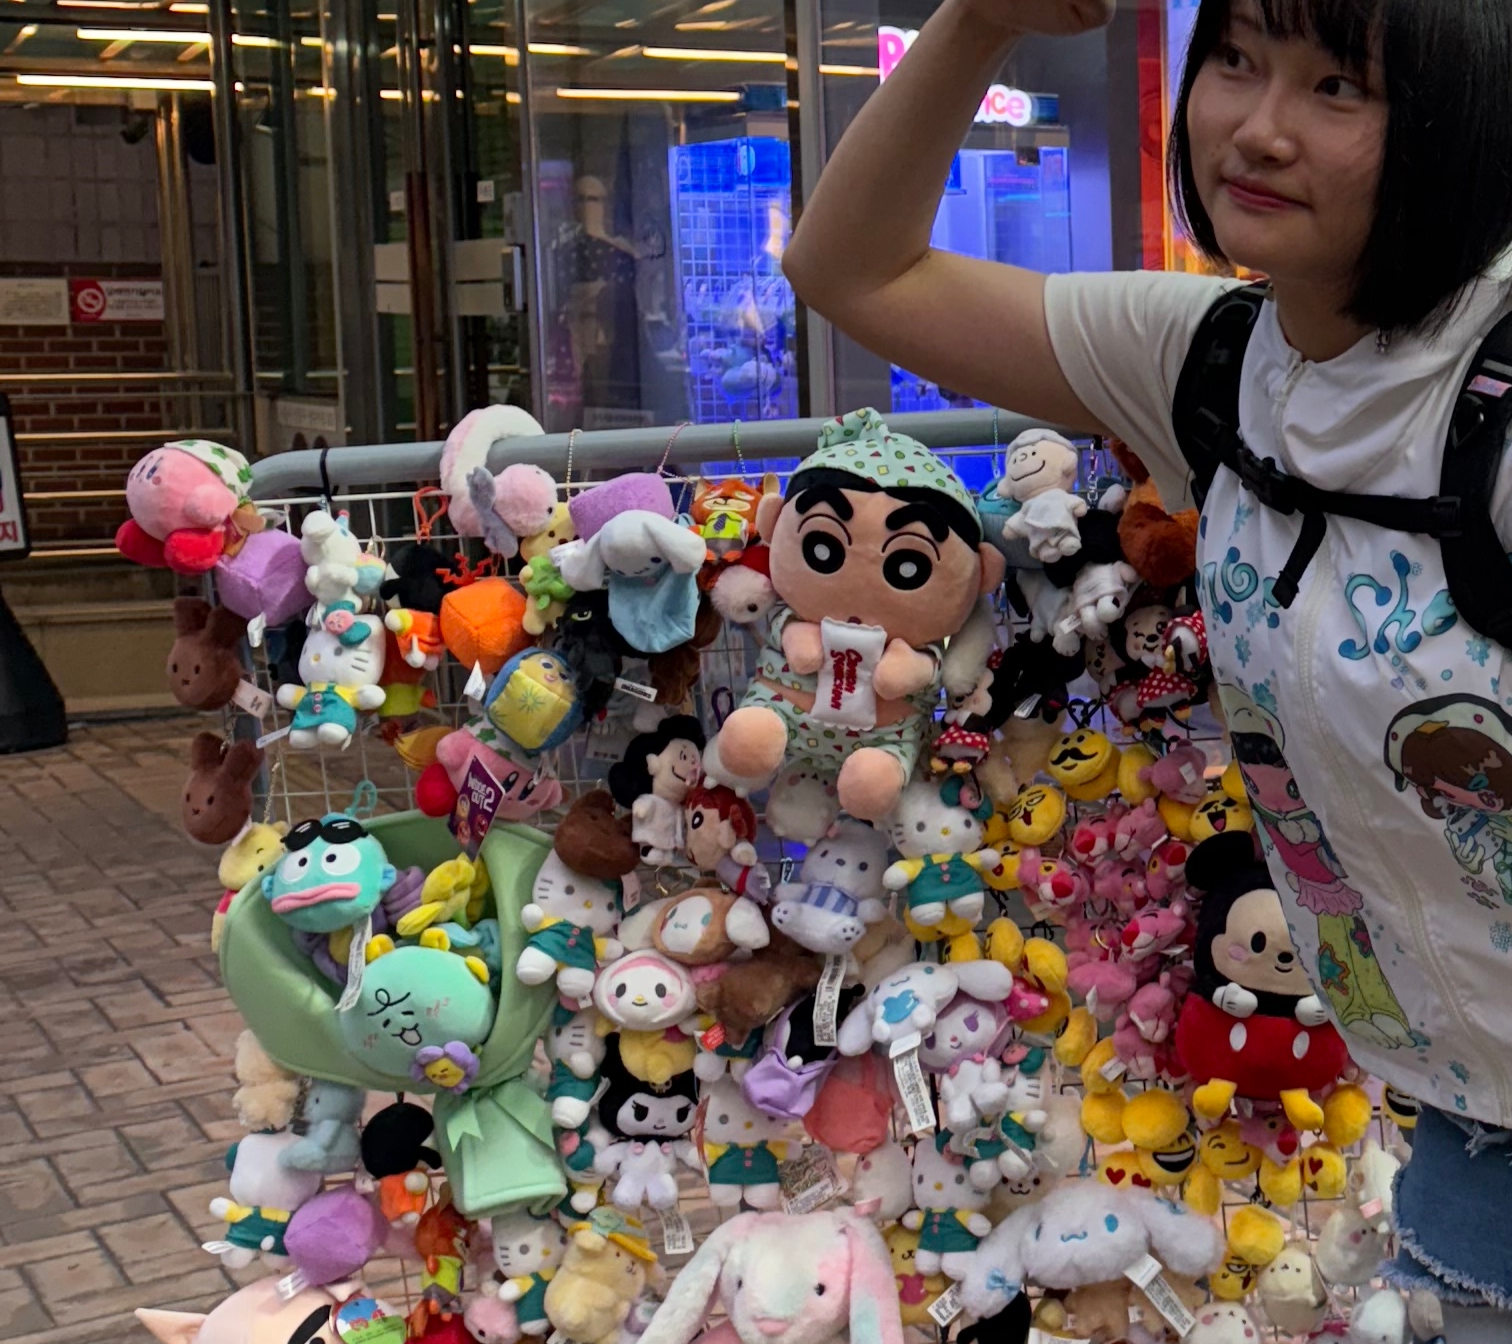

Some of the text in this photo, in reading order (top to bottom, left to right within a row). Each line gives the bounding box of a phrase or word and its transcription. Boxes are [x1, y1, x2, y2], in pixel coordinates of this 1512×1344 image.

[467, 771, 487, 794] INSIDE
[471, 786, 495, 813] OUT 2
